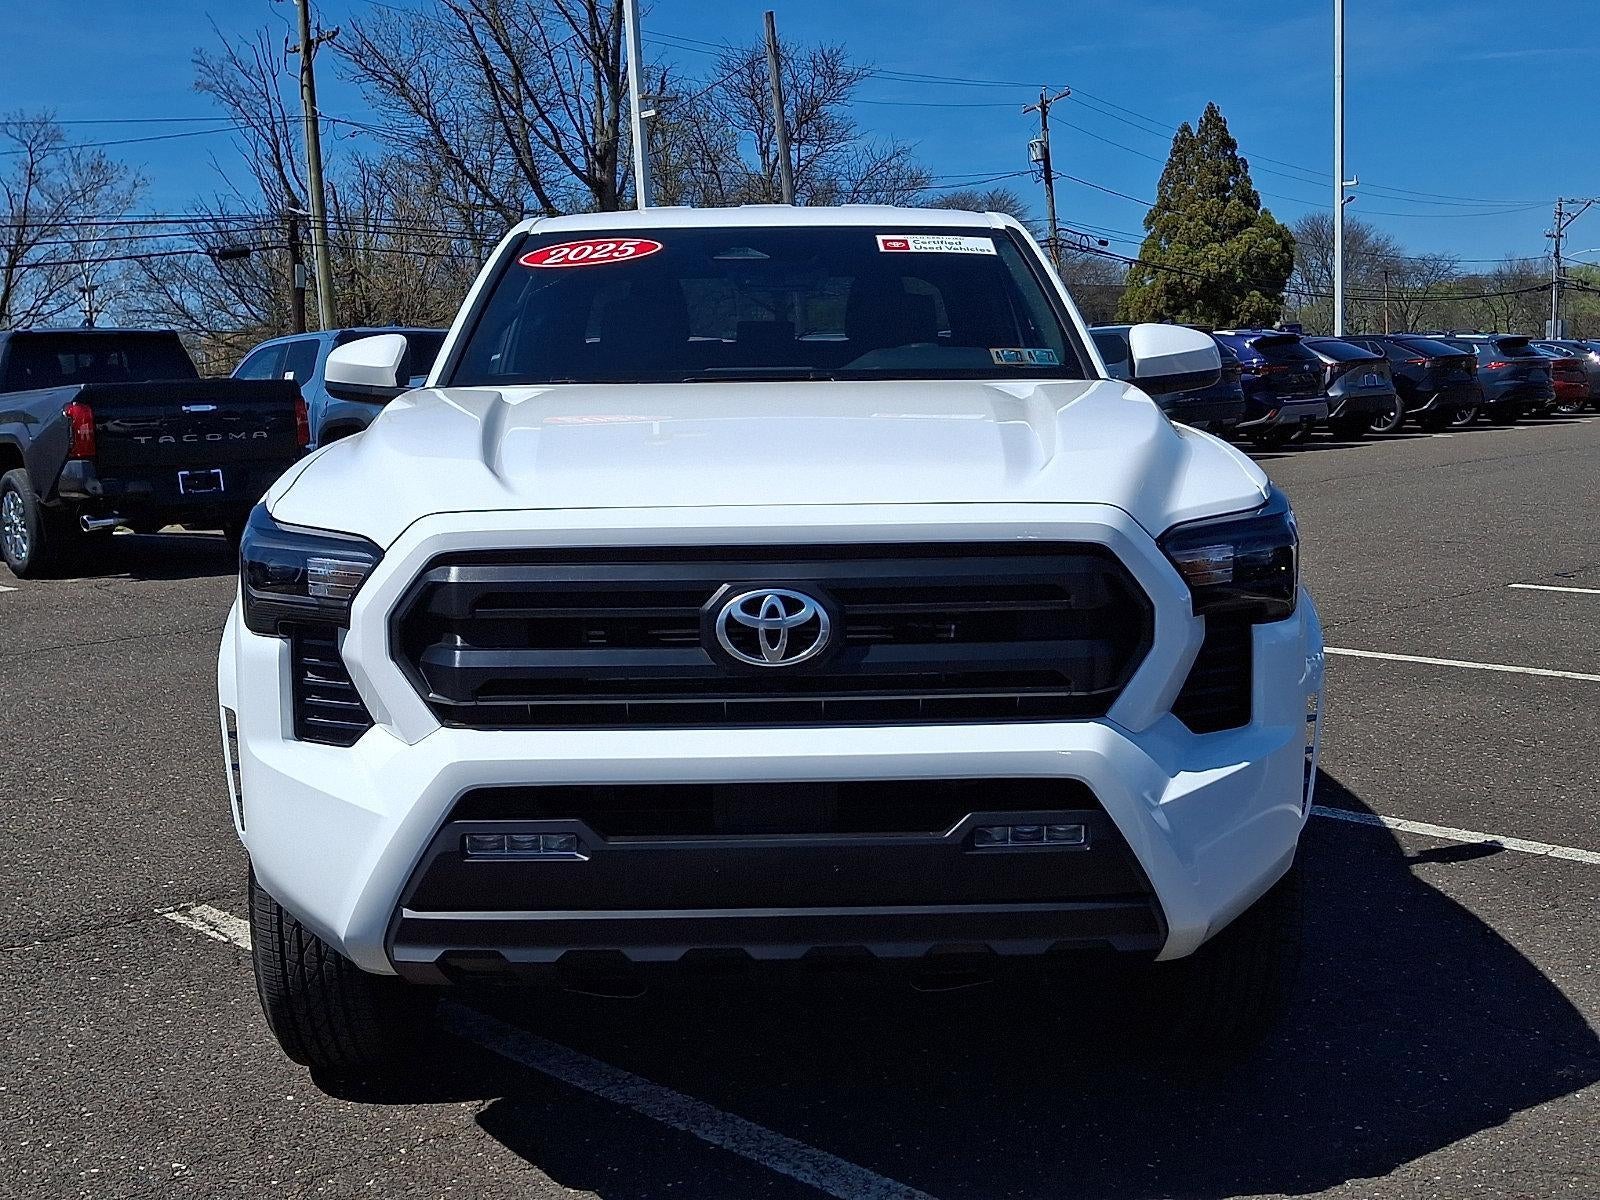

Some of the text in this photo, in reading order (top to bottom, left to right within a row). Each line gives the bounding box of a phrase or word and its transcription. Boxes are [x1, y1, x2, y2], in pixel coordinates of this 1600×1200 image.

[541, 241, 641, 265] 2025
[945, 245, 992, 253] Vehicles
[133, 431, 268, 444] TACOMA
